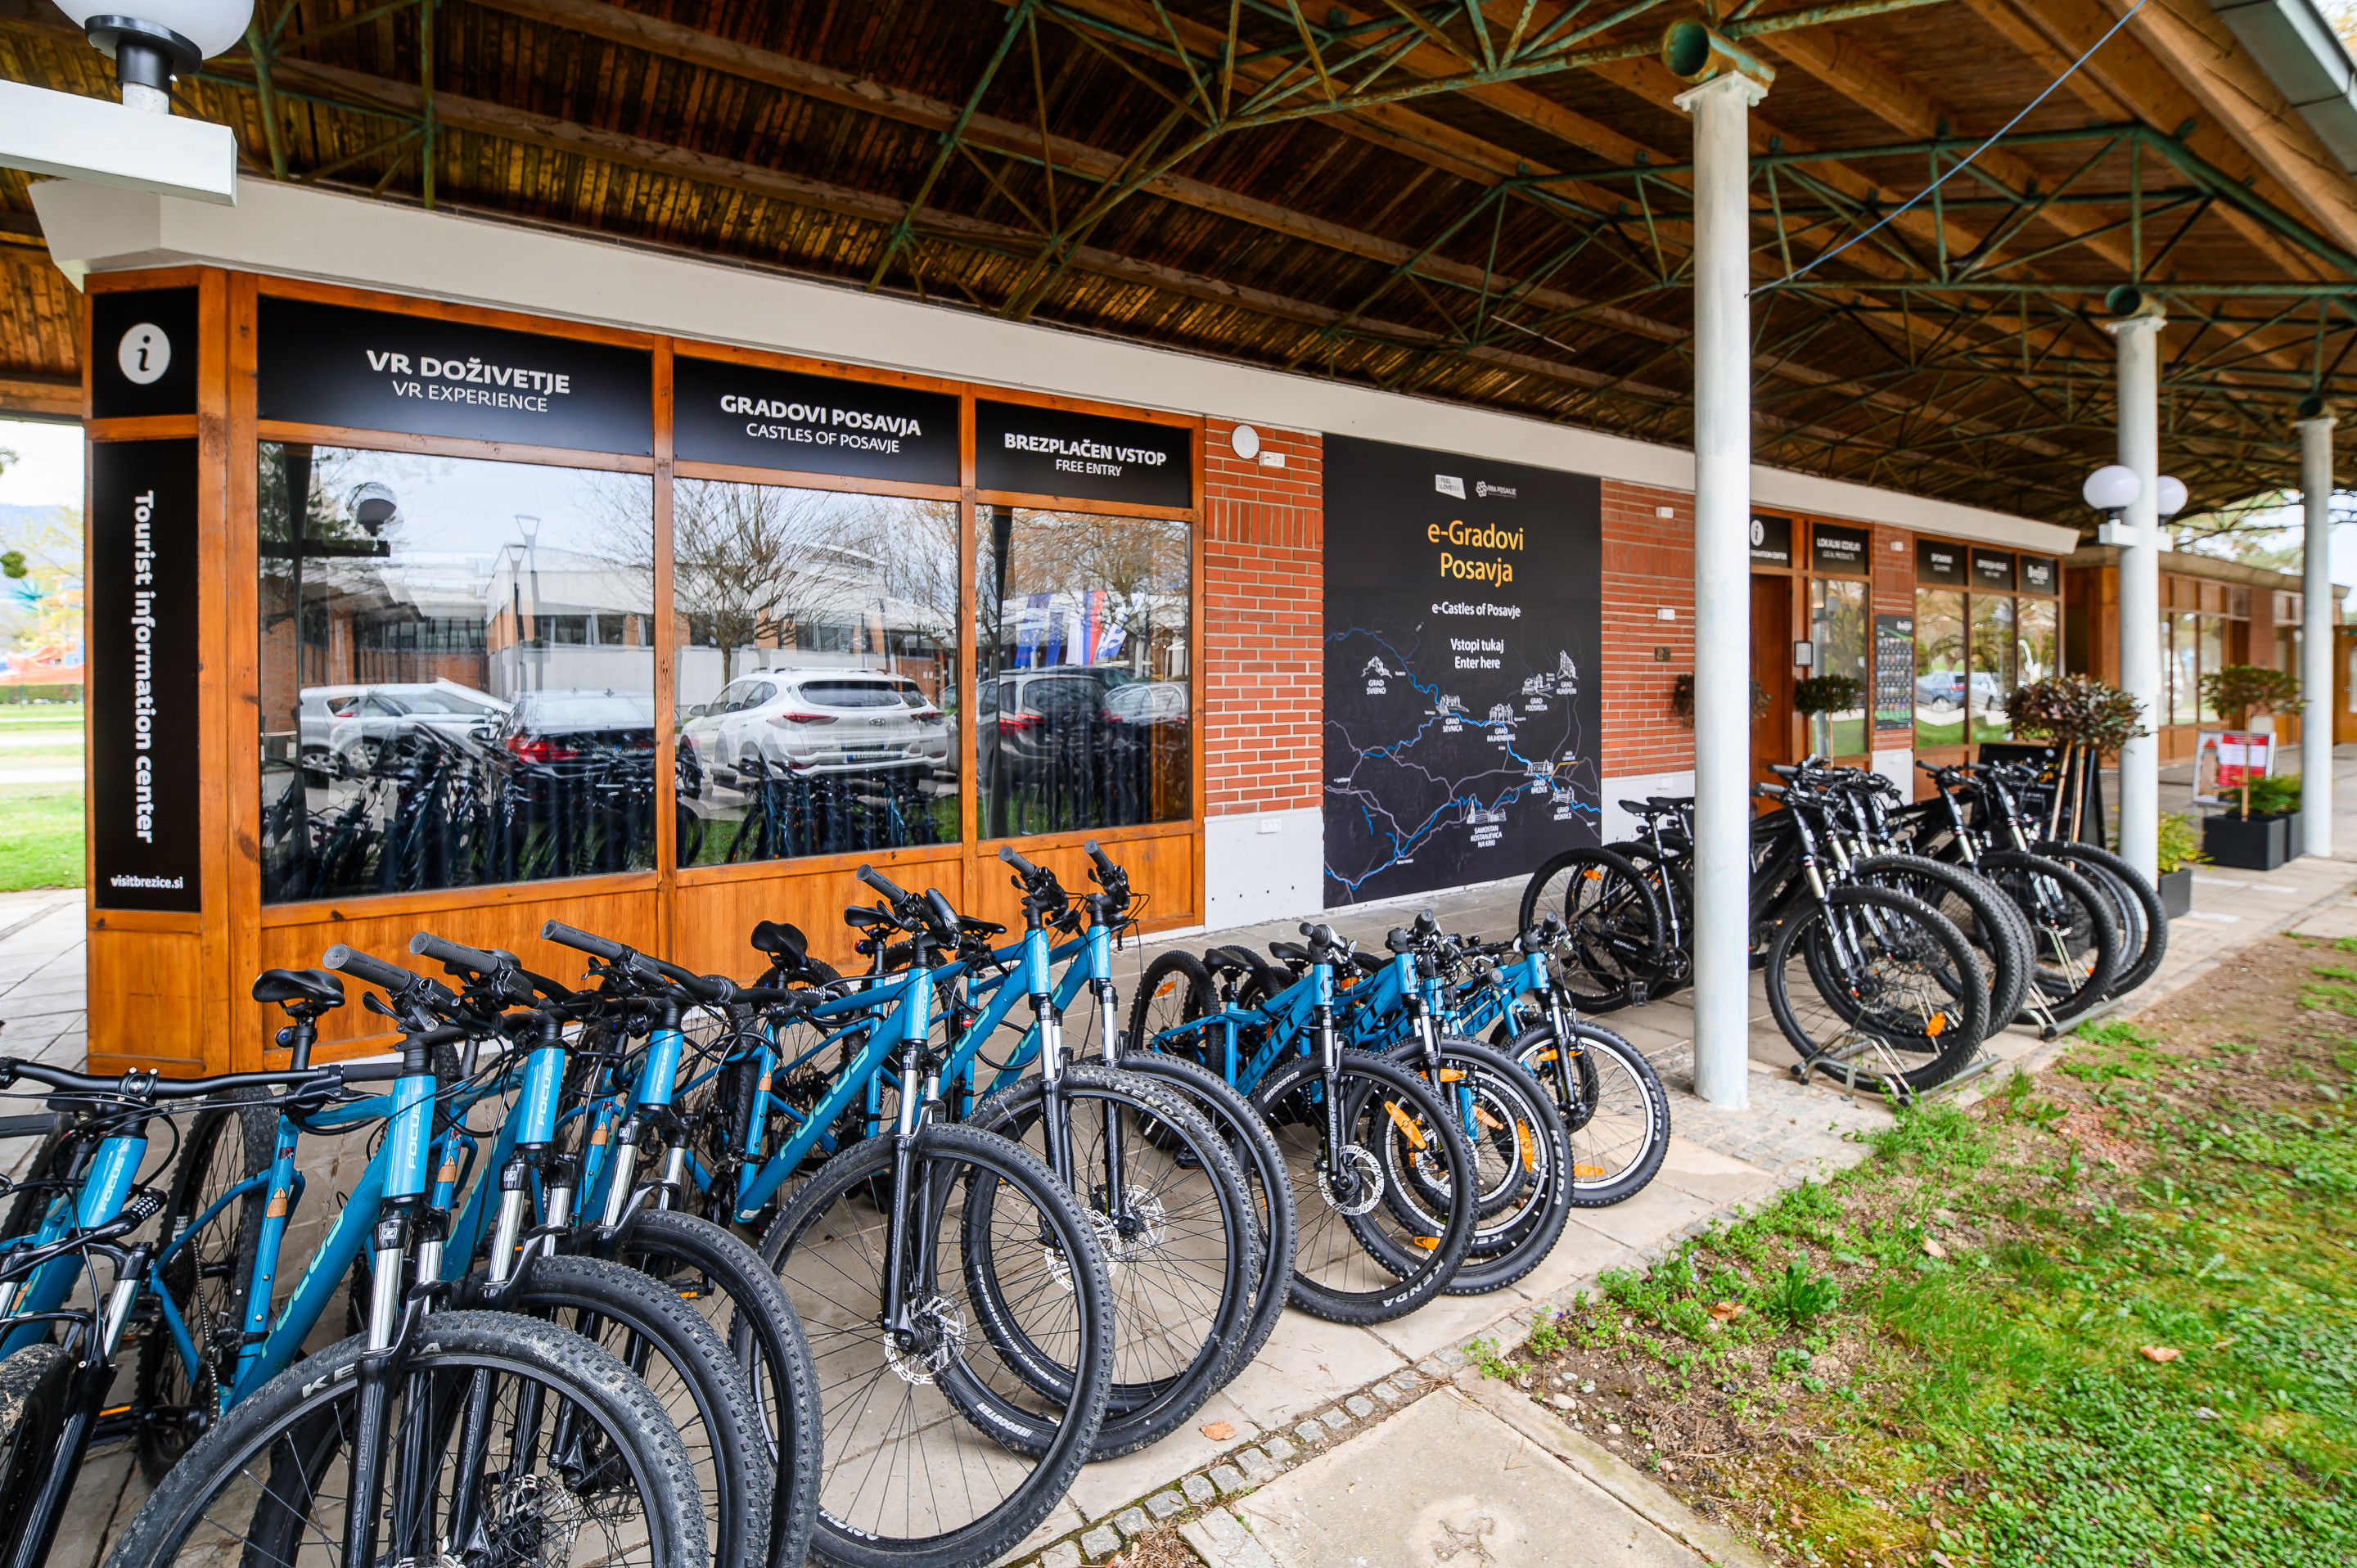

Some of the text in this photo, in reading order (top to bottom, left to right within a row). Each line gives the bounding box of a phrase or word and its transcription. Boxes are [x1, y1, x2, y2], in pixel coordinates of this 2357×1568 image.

[366, 349, 570, 395] VR DOŽIVETJE
[392, 380, 548, 412] VR EXPERIENCE
[720, 394, 922, 436] GRADOVI POSAVJA
[746, 422, 900, 453] CASTLES OF POSAVJE
[1004, 432, 1167, 466] BREZPLAČEN VSTOP
[1056, 458, 1122, 478] FREE ENTRY
[1427, 520, 1524, 551] e-Gradovi
[1440, 552, 1513, 588] Posavja
[1431, 602, 1521, 619] e-Castles of Posavje
[131, 490, 155, 844] Tourist information center
[1450, 638, 1504, 655] Vstopi tukaj
[1454, 656, 1501, 669] Enter here
[110, 874, 183, 890] visitbrezice.si
[921, 984, 930, 1031] FOCUS
[656, 1047, 669, 1093] FOCUS
[537, 1064, 554, 1127] FOCUS
[1113, 1083, 1186, 1126] KENDA
[1643, 1077, 1662, 1142] KENDA
[408, 1100, 422, 1169] FOCUS
[99, 1156, 126, 1213] FOCUS
[1549, 1129, 1566, 1205] KENDA
[1382, 1259, 1444, 1308] KENDA
